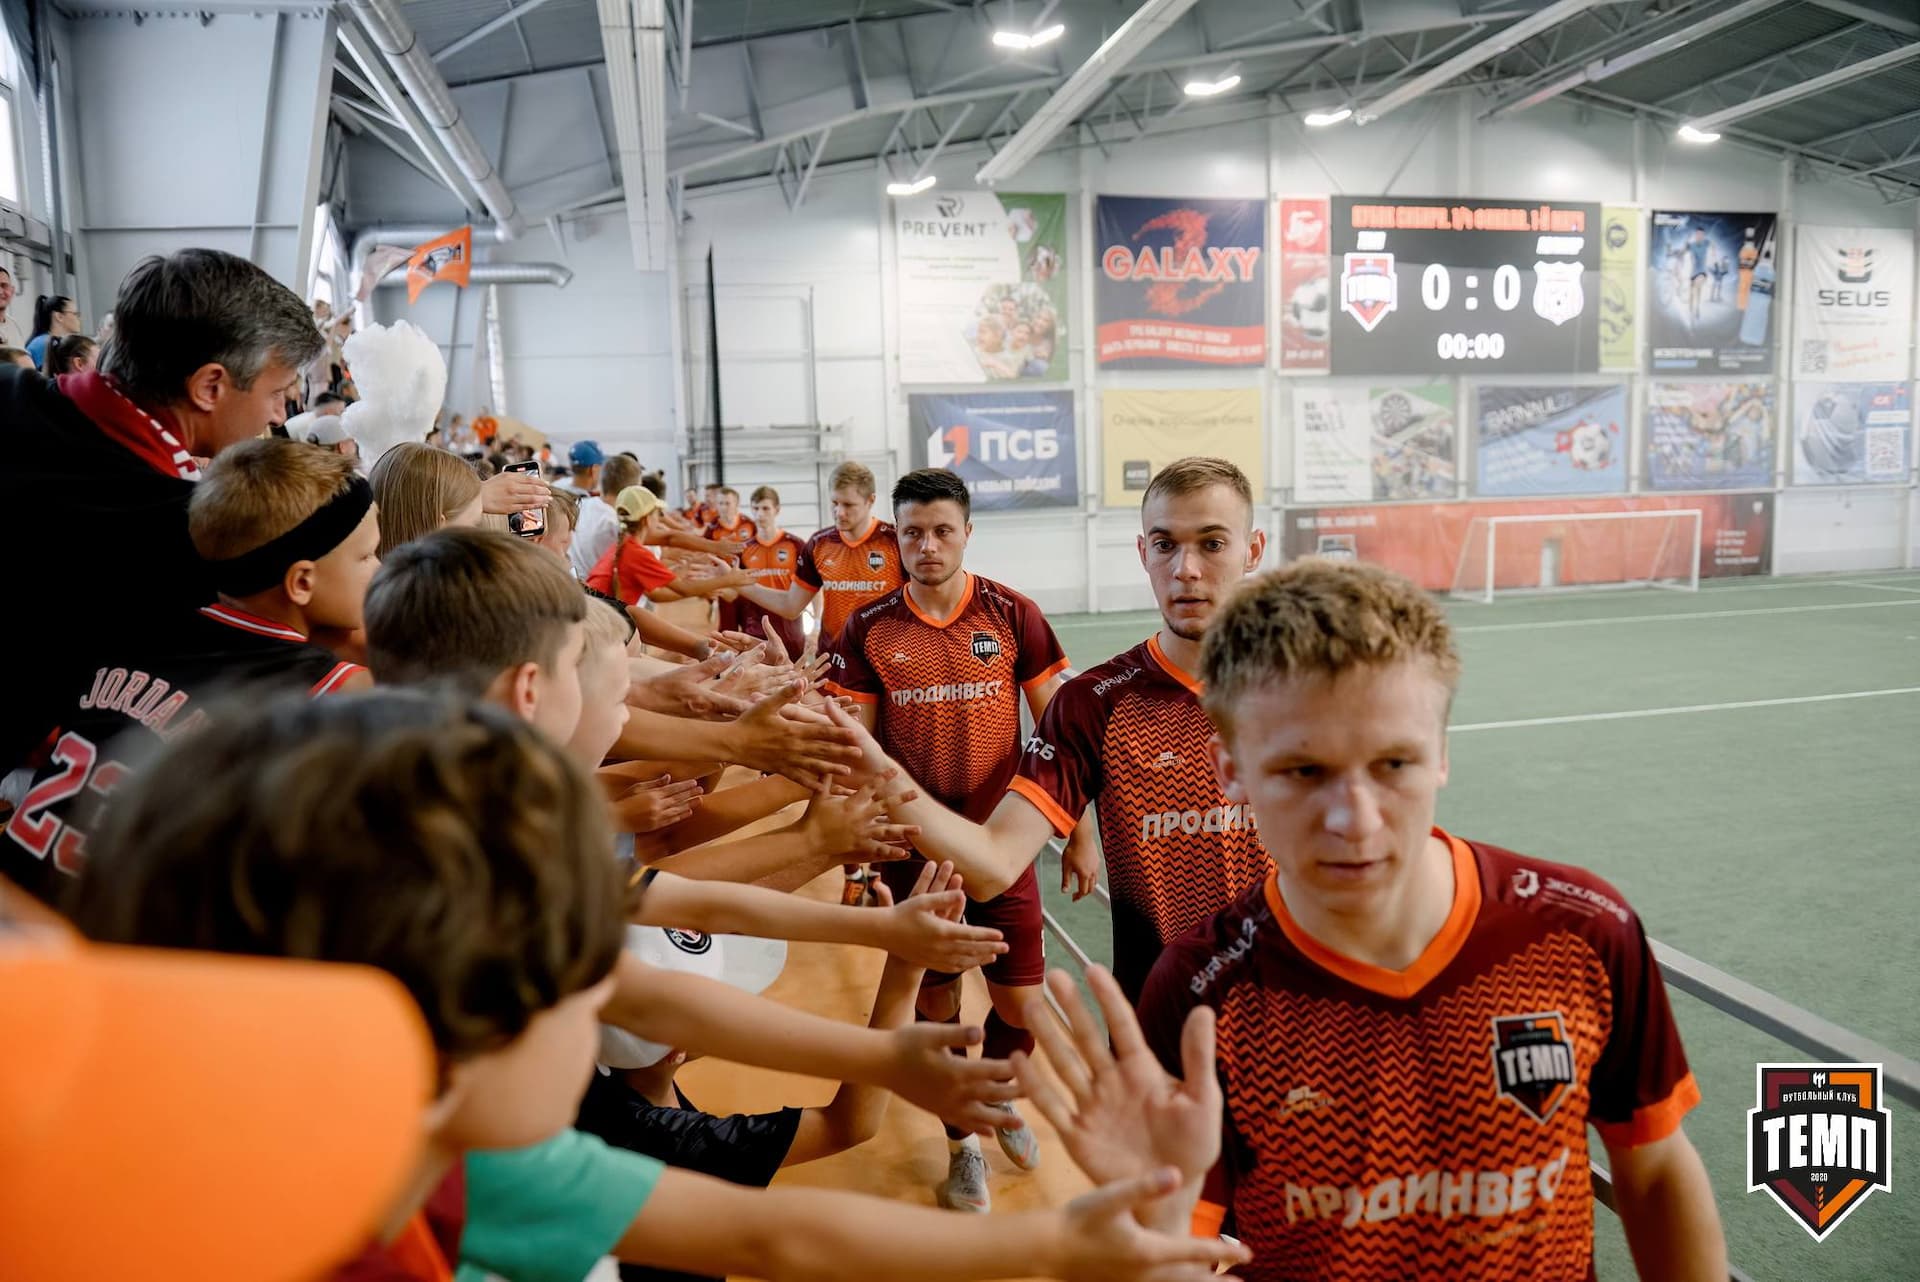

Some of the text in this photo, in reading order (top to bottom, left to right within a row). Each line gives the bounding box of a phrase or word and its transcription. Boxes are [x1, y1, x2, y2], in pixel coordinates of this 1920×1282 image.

[903, 220, 987, 238] PREVENT
[1103, 246, 1260, 282] GALAXY
[1818, 289, 1891, 307] SEUS
[1437, 333, 1504, 359] 00:00
[980, 428, 1059, 462] ПСБ
[973, 640, 999, 655] ТЕМП
[891, 680, 1003, 707] ПРОДИНВЕСТ
[1500, 1043, 1570, 1087] ТЕМП
